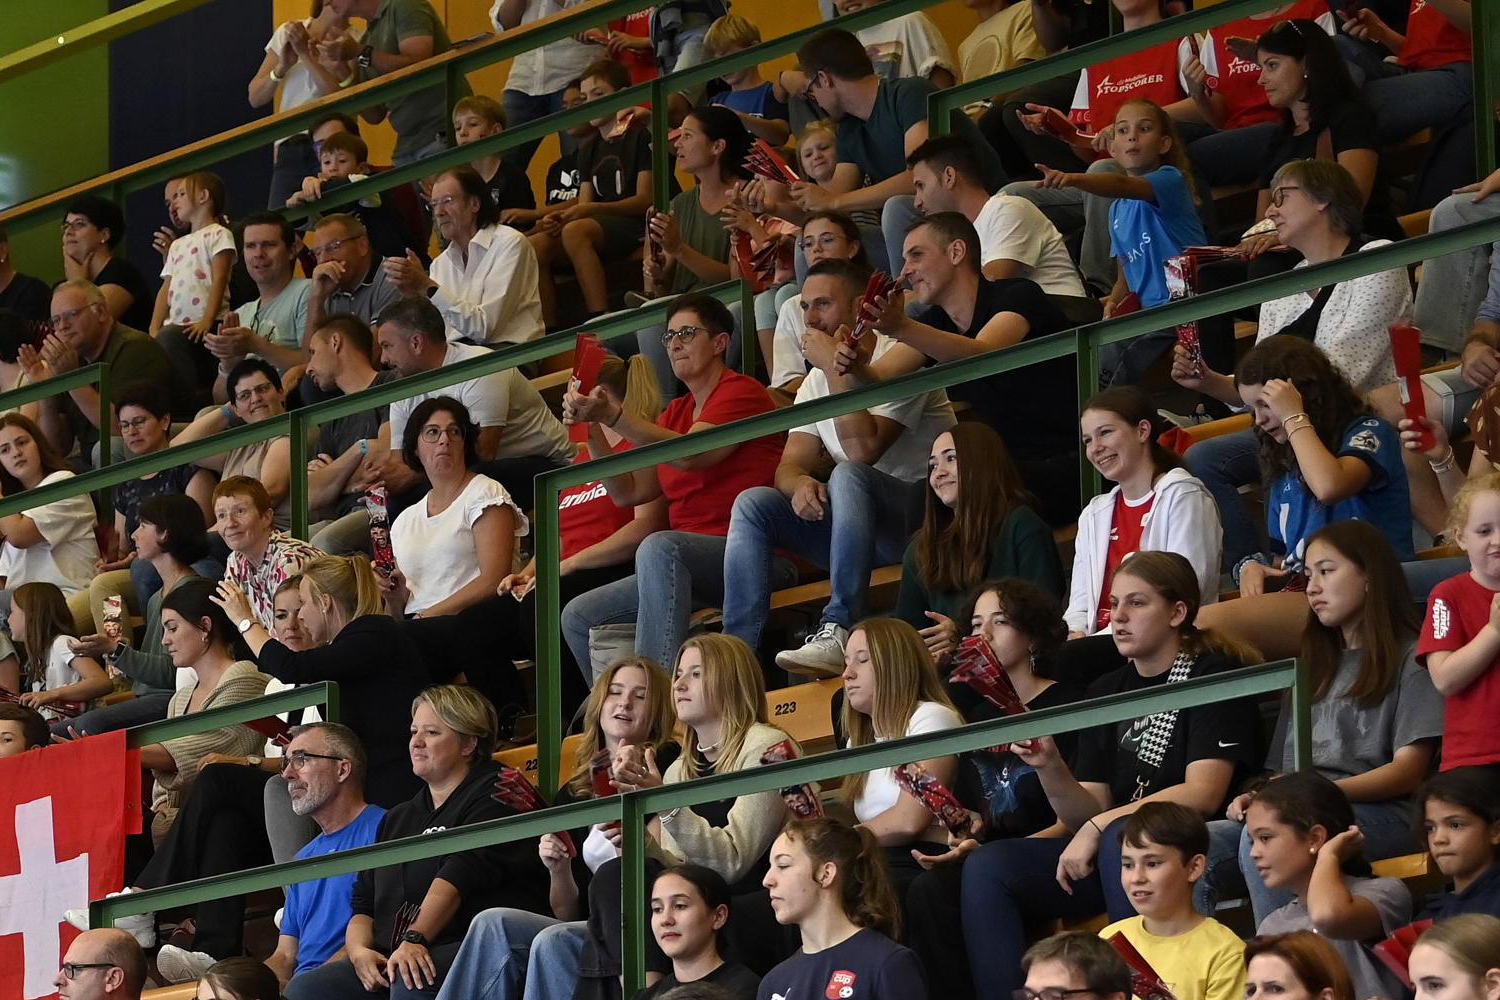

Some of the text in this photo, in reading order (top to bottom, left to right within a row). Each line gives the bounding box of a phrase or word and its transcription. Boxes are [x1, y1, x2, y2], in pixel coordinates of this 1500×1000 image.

[1103, 74, 1164, 93] TOPSCORER
[775, 701, 797, 716] 223
[525, 758, 538, 771] 22
[833, 976, 851, 985] cup
